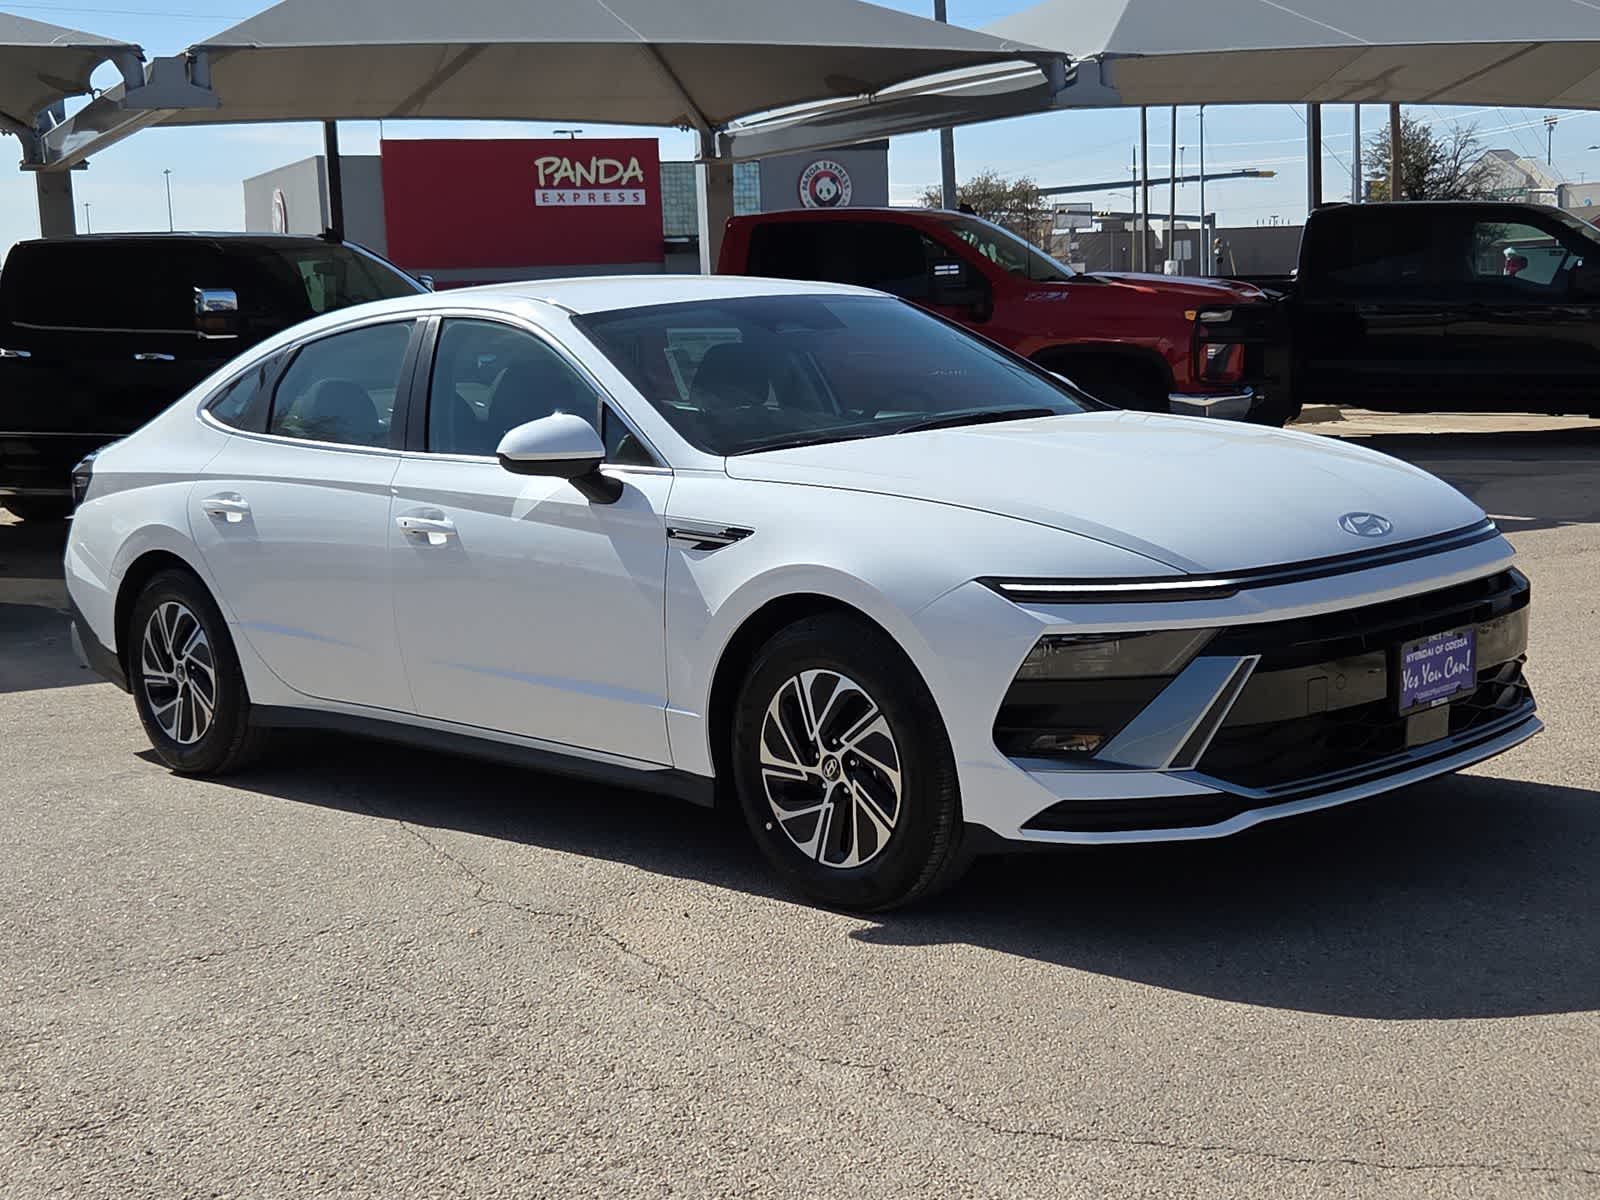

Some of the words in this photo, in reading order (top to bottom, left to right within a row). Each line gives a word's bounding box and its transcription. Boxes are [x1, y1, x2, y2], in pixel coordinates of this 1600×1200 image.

[534, 156, 643, 187] PANDA
[542, 192, 640, 202] EXPRESS
[1402, 668, 1418, 692] Yes
[1422, 663, 1442, 685] You
[1444, 649, 1471, 678] Can!
